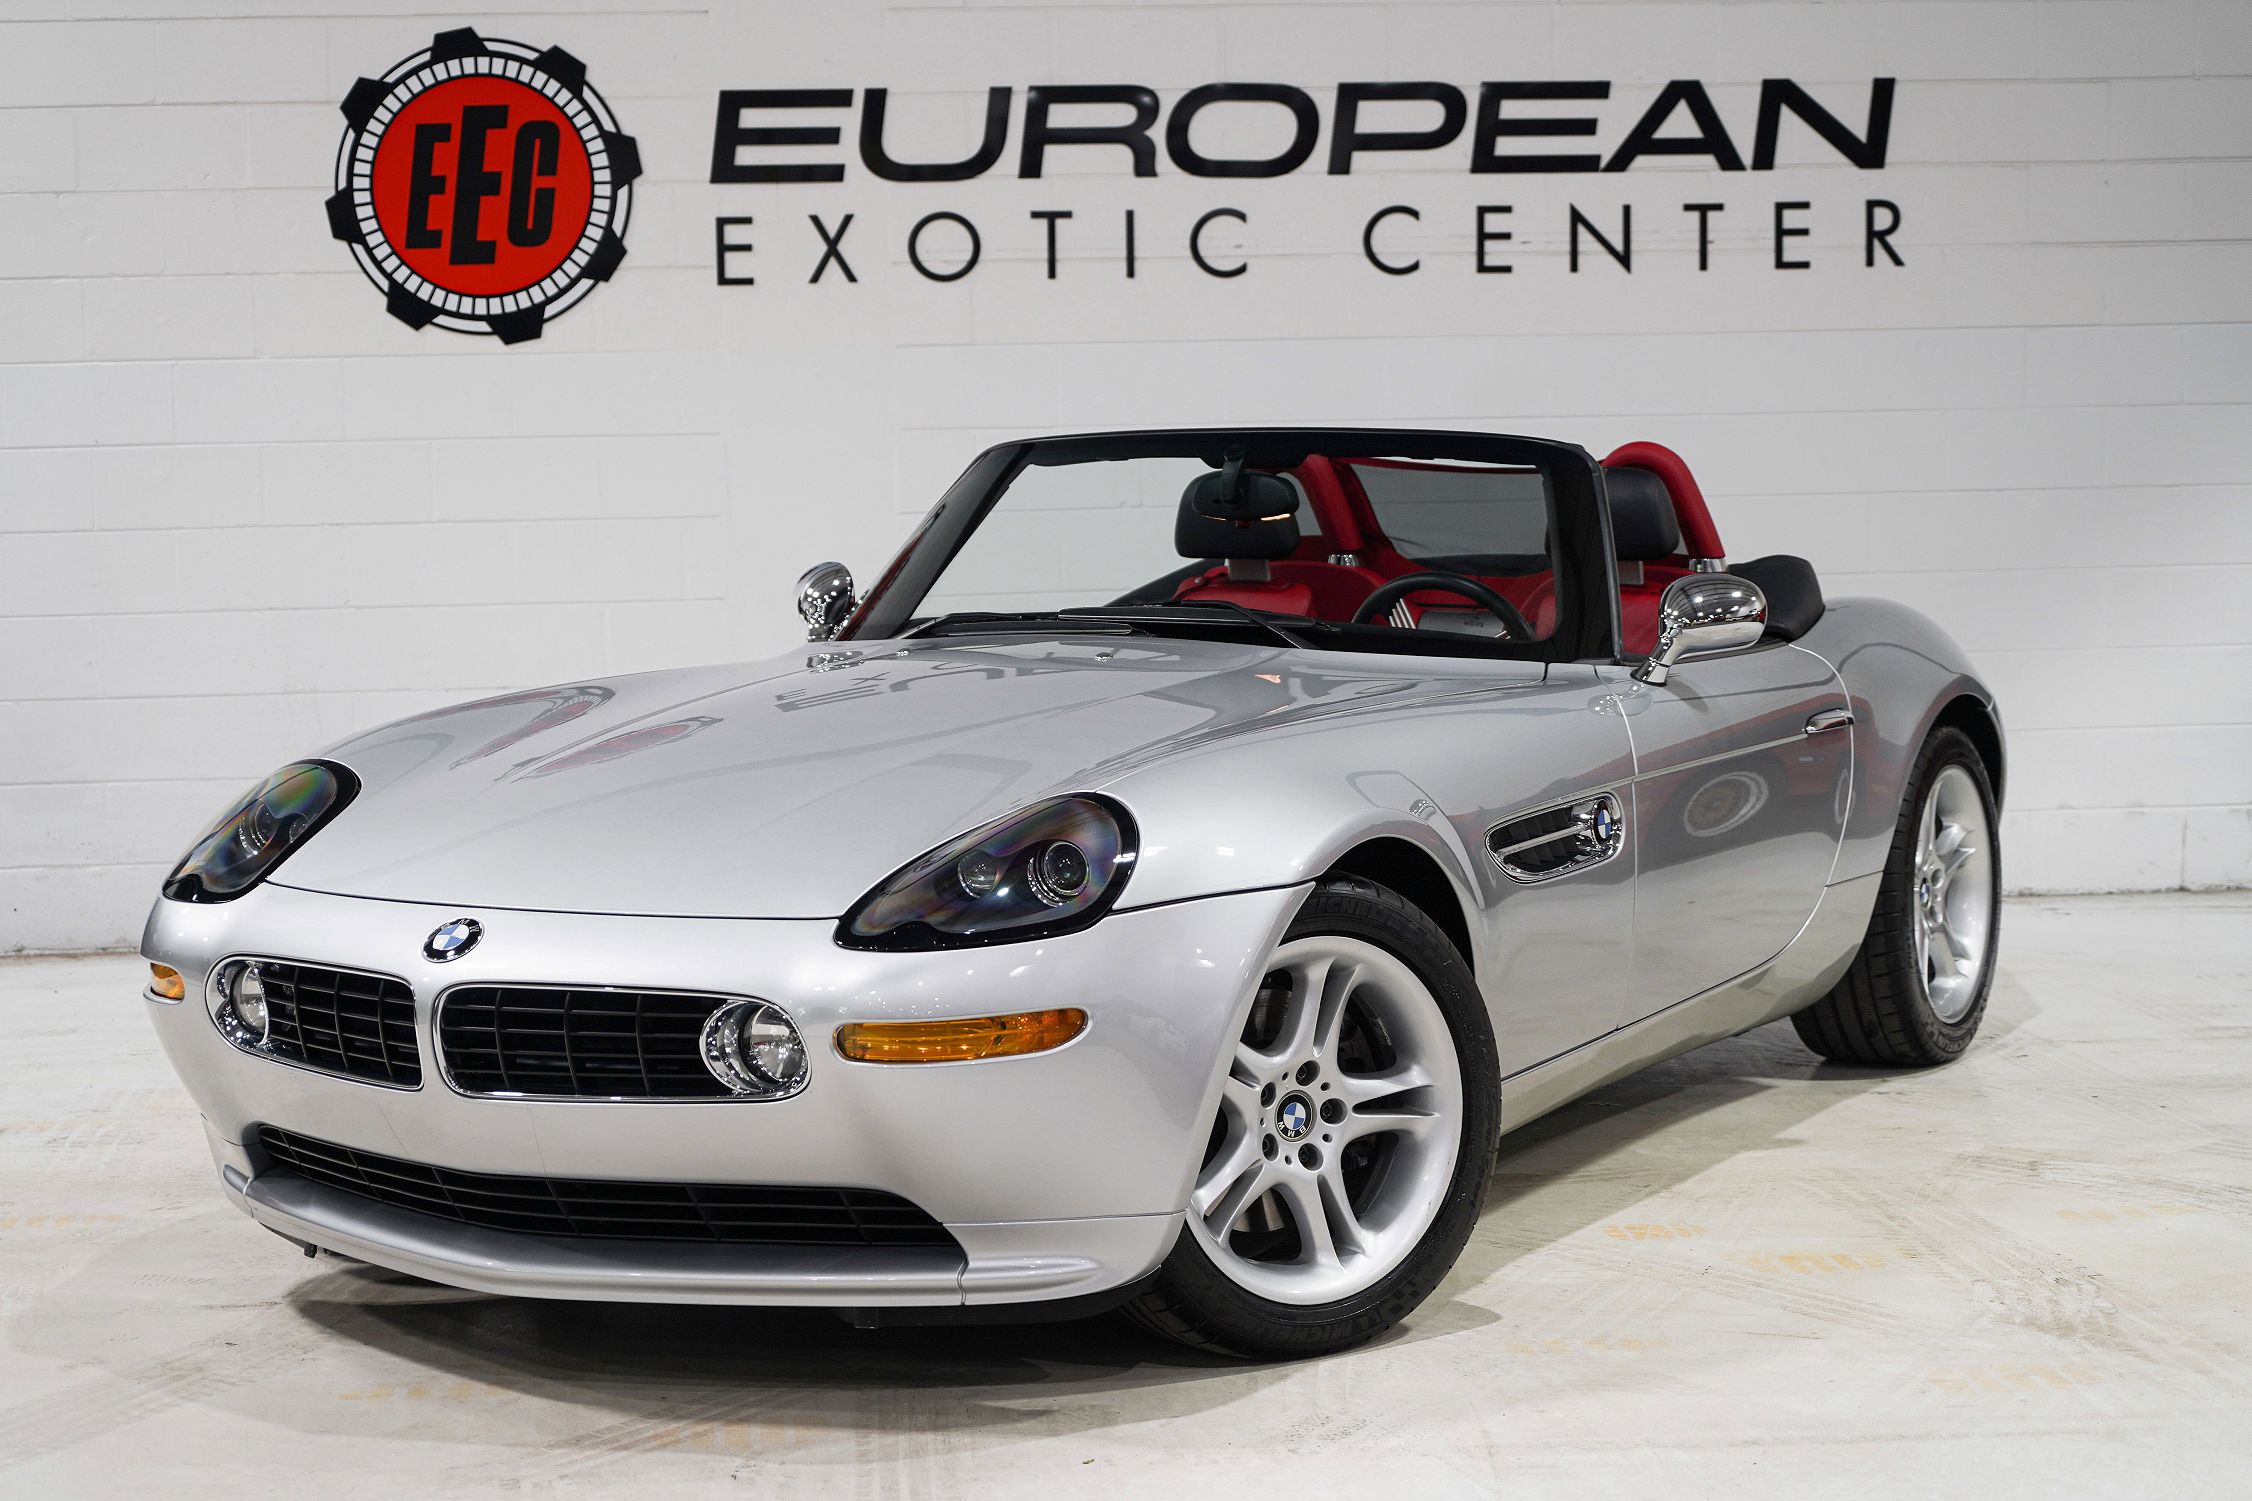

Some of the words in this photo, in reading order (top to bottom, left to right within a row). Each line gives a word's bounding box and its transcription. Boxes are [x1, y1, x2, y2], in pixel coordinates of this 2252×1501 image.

[710, 78, 1896, 184] EUROPEAN
[405, 104, 560, 265] EEC
[715, 208, 1248, 286] EXOTIC
[1363, 200, 1905, 276] CENTER
